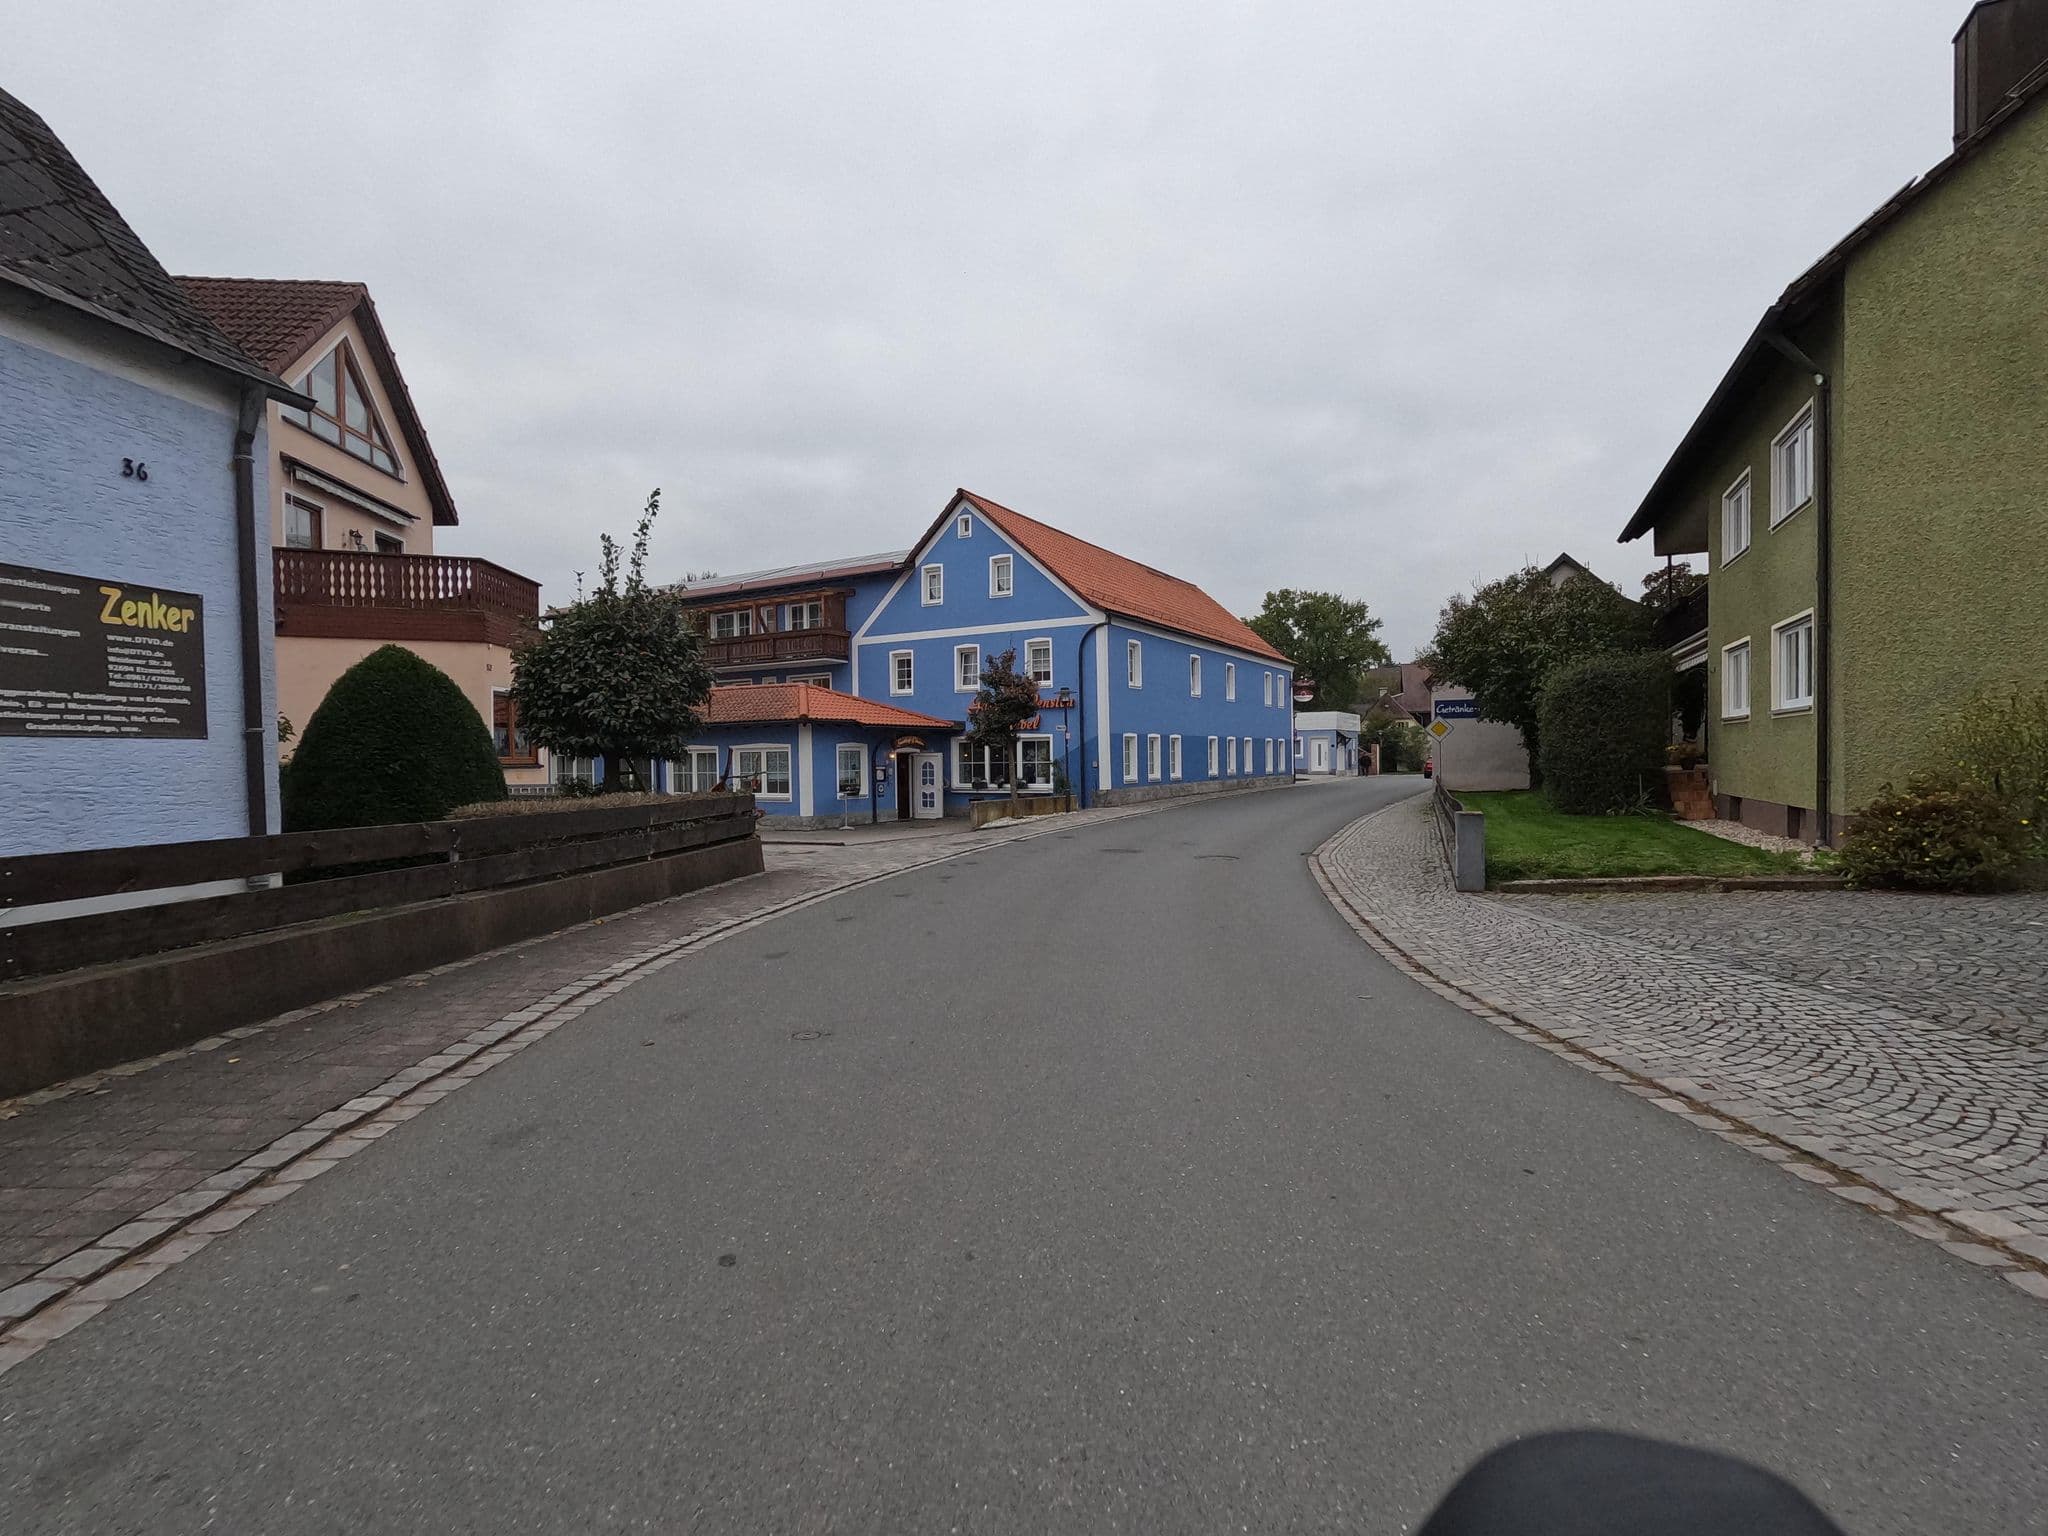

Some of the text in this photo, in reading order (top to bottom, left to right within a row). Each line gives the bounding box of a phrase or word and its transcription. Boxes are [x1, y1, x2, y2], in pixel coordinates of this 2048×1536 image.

[122, 457, 148, 481] 36
[98, 586, 195, 633] Zenker
[106, 634, 175, 647] www.DTVD.de
